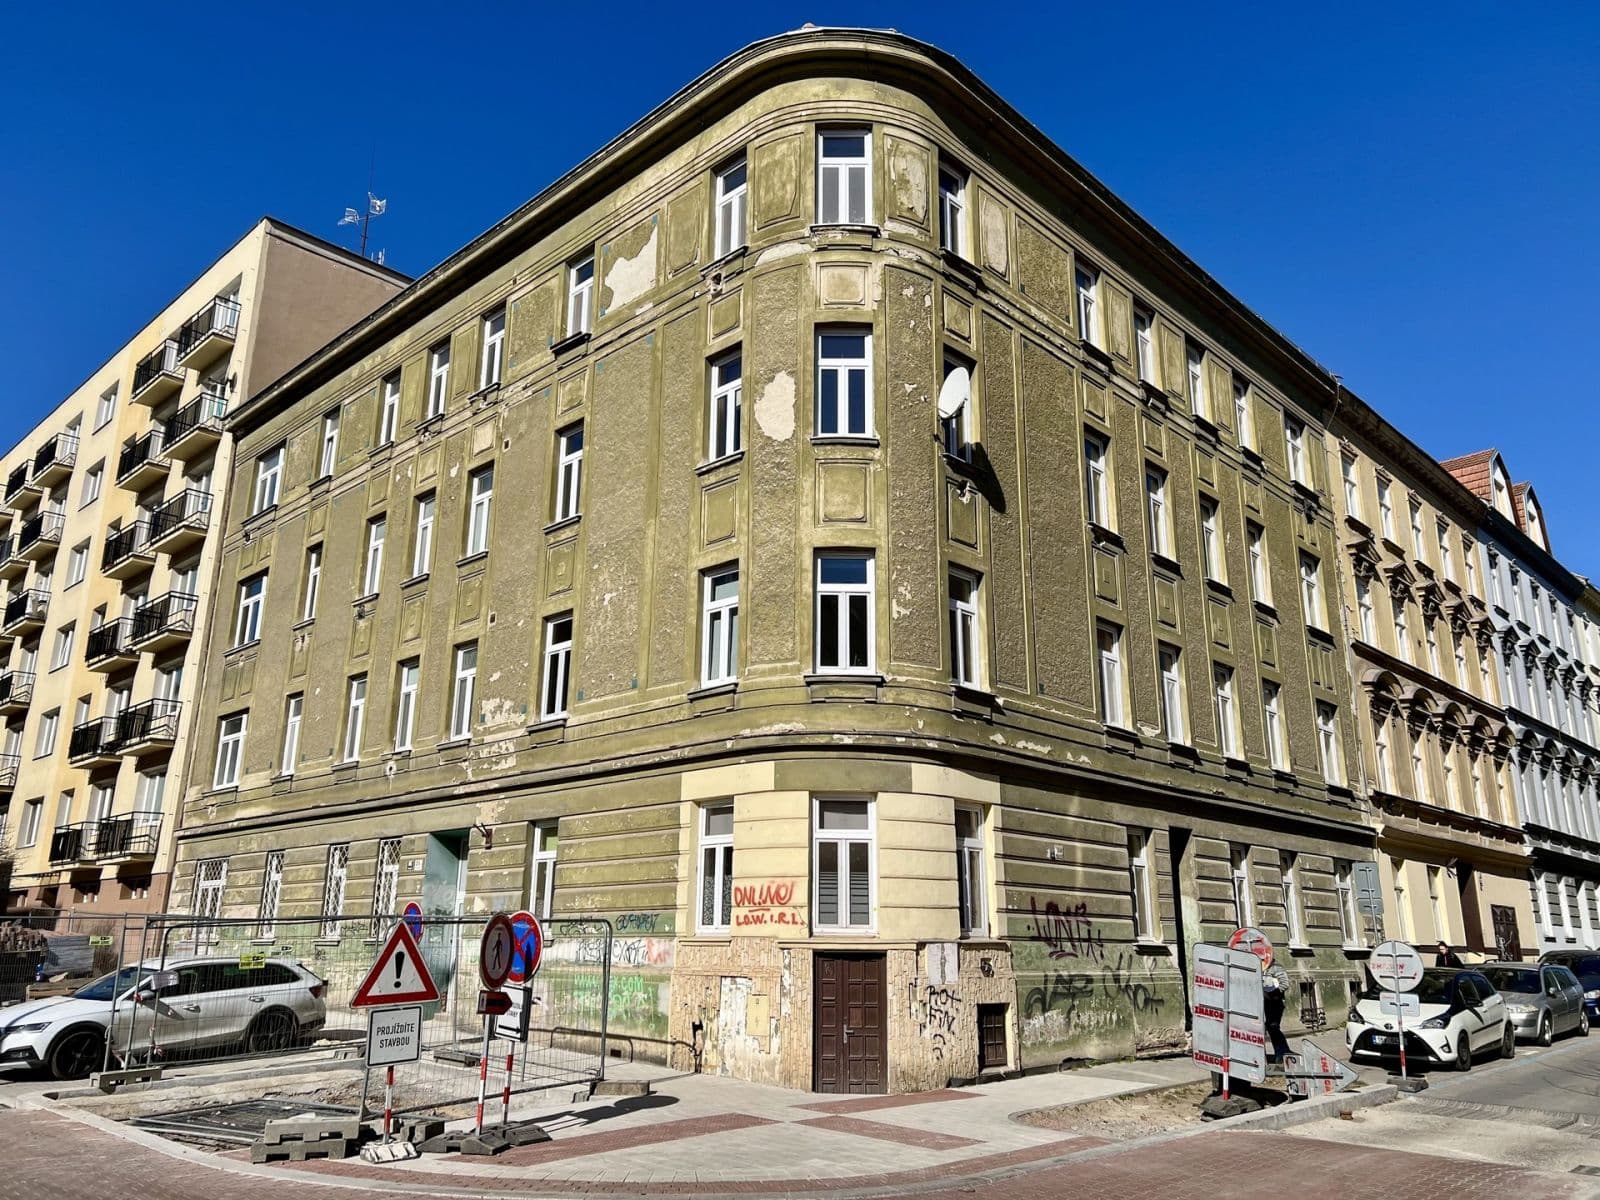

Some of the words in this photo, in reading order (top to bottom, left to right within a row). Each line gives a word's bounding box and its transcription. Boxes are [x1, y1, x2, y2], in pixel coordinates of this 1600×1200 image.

[376, 1022, 415, 1036] PROJÍŽDÍTE
[379, 1036, 410, 1049] STAVBOU
[1230, 1030, 1264, 1045] ZNAKOM
